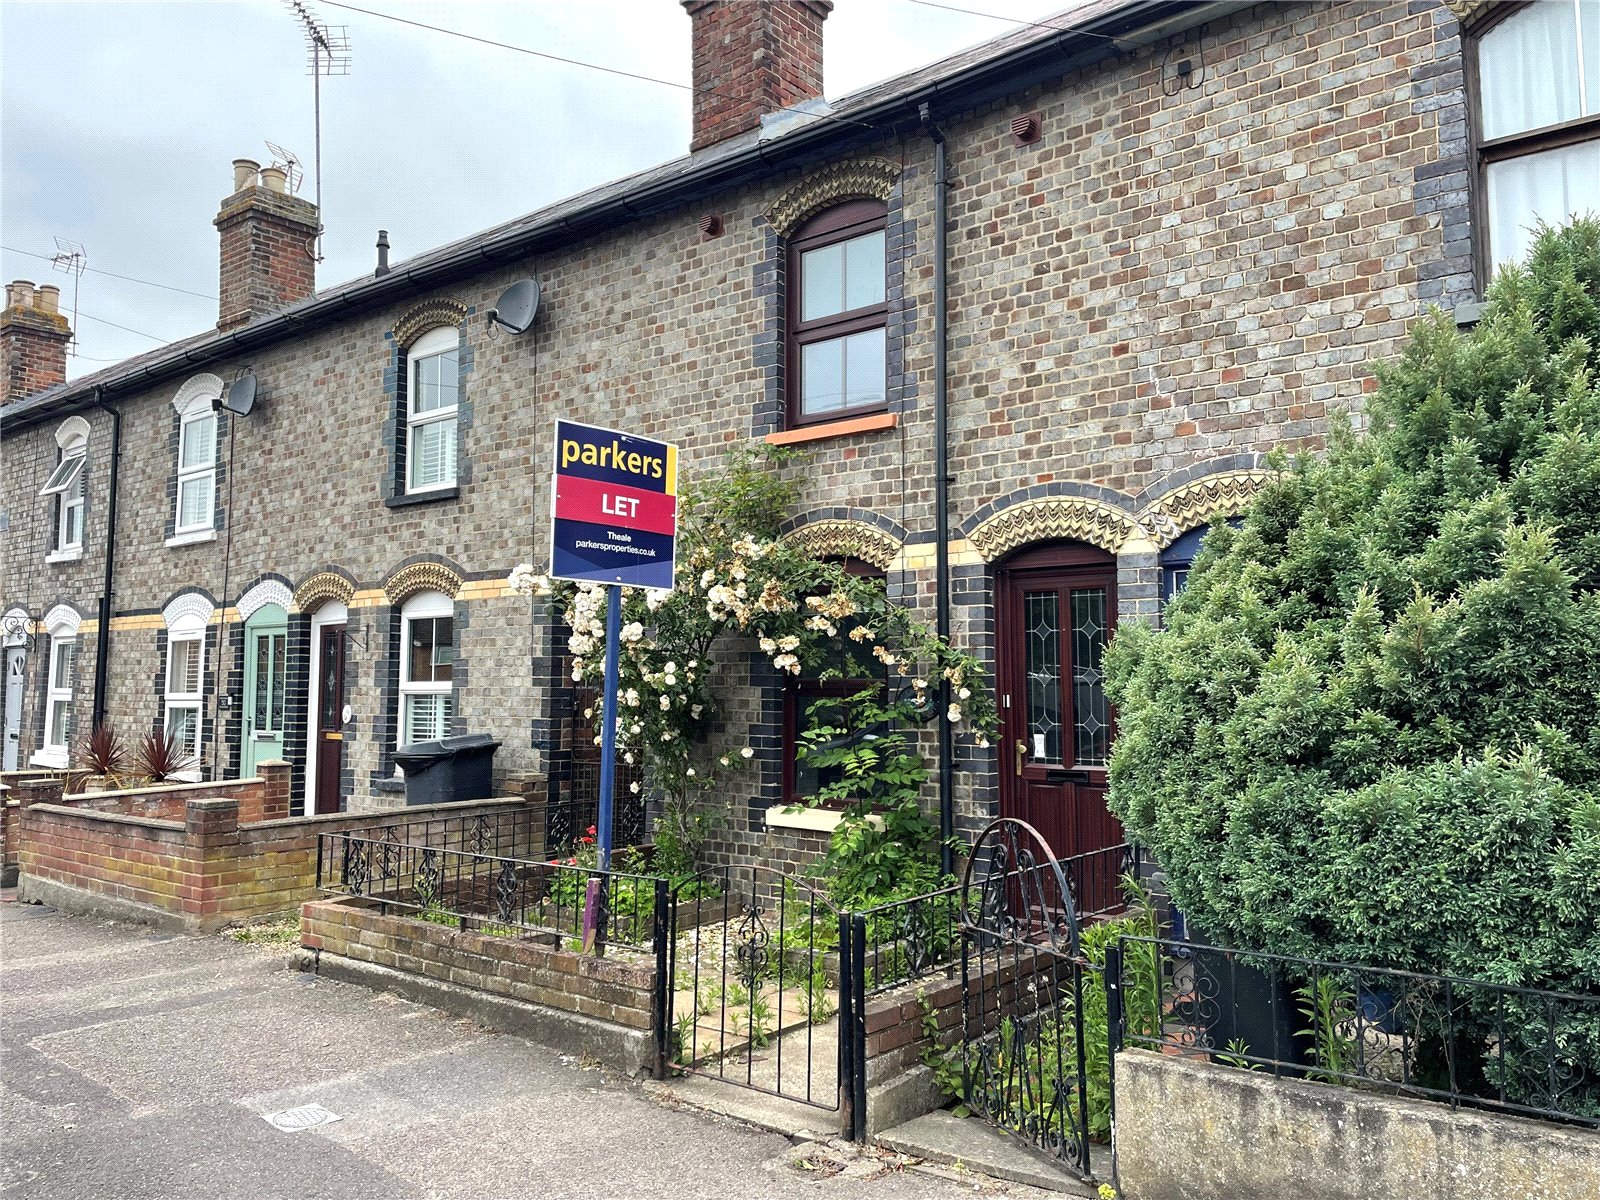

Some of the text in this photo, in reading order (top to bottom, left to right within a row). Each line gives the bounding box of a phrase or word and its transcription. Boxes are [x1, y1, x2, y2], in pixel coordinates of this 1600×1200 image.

[561, 438, 663, 479] parkers
[601, 493, 640, 518] LET
[606, 531, 632, 543] Theale
[575, 540, 656, 557] parkersproperties.co.uk
